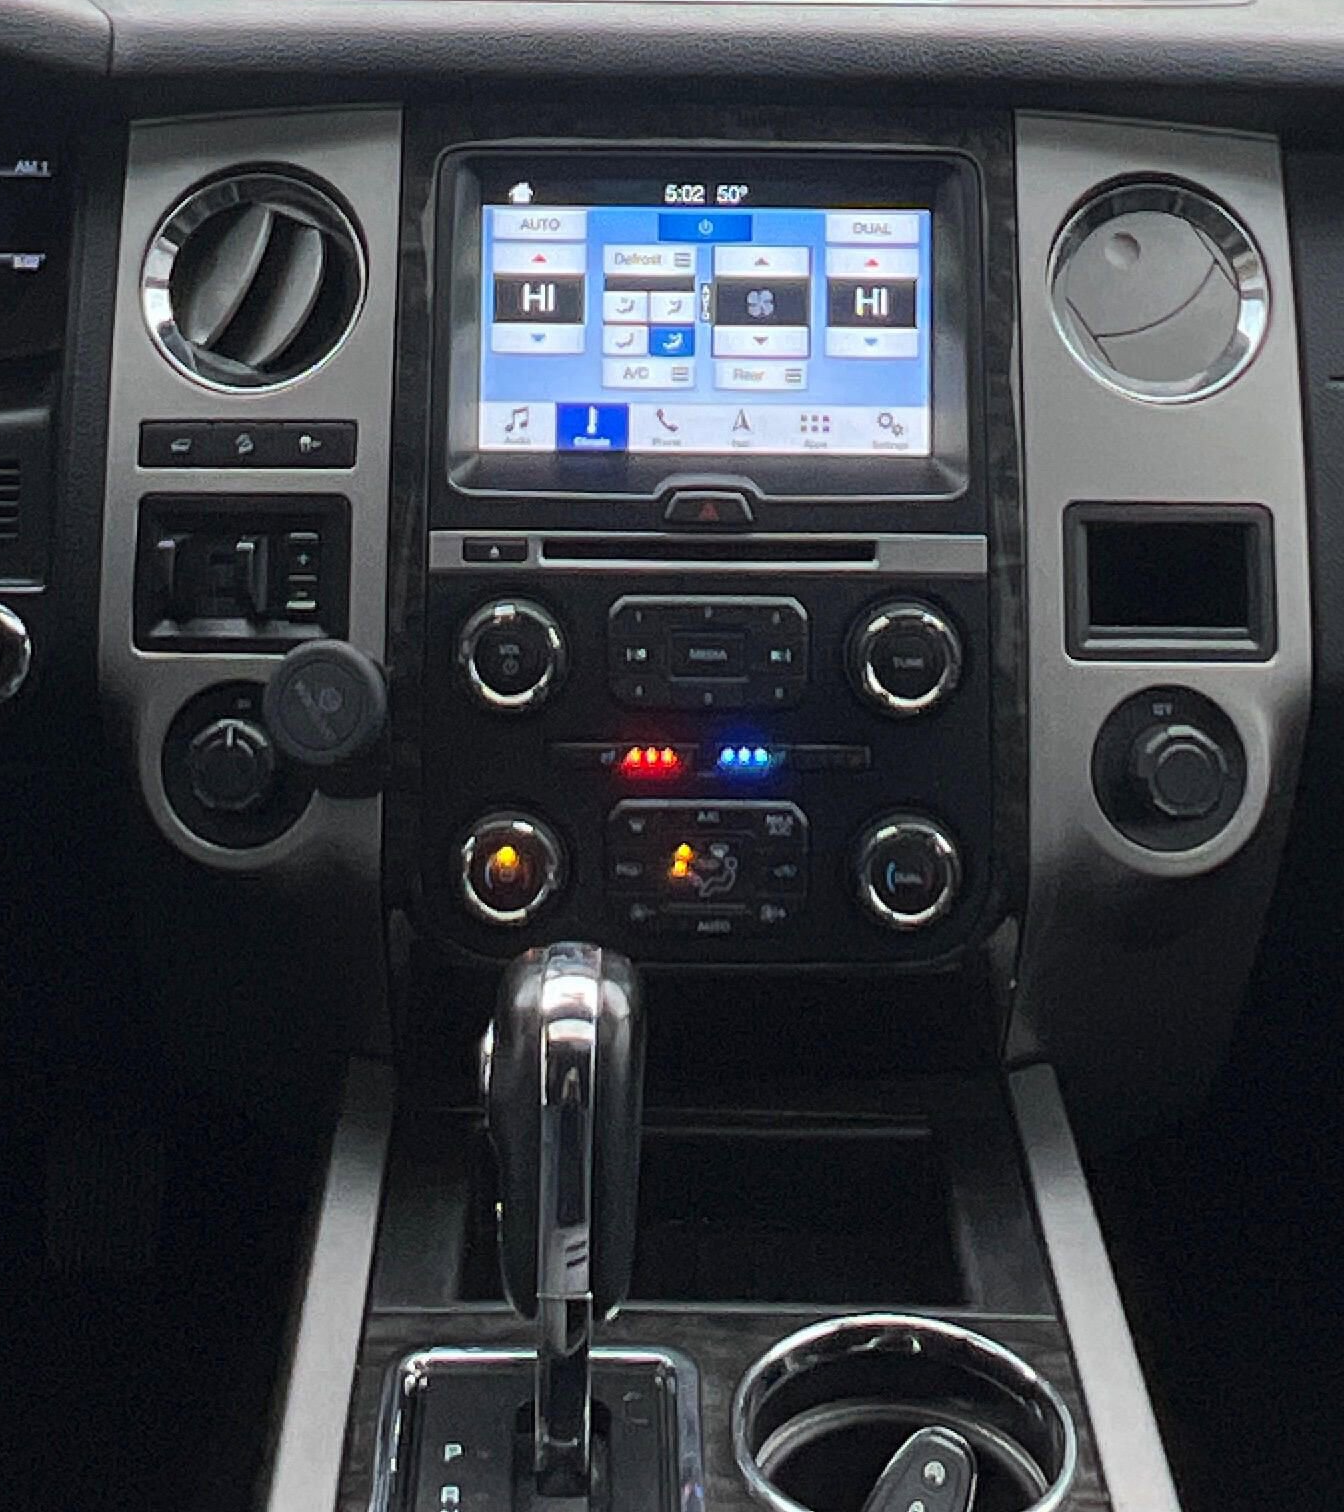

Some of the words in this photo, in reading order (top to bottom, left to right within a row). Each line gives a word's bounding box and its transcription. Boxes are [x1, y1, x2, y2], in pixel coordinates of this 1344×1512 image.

[665, 185, 705, 203] 5:02
[520, 217, 561, 232] AUTO
[853, 222, 891, 235] DUAL
[614, 252, 662, 267] Defrost
[523, 283, 555, 312] HI
[856, 287, 888, 316] HI
[623, 366, 649, 380] A/C
[733, 368, 764, 382] Rear
[444, 1444, 462, 1462] P
[441, 1486, 460, 1504] R
